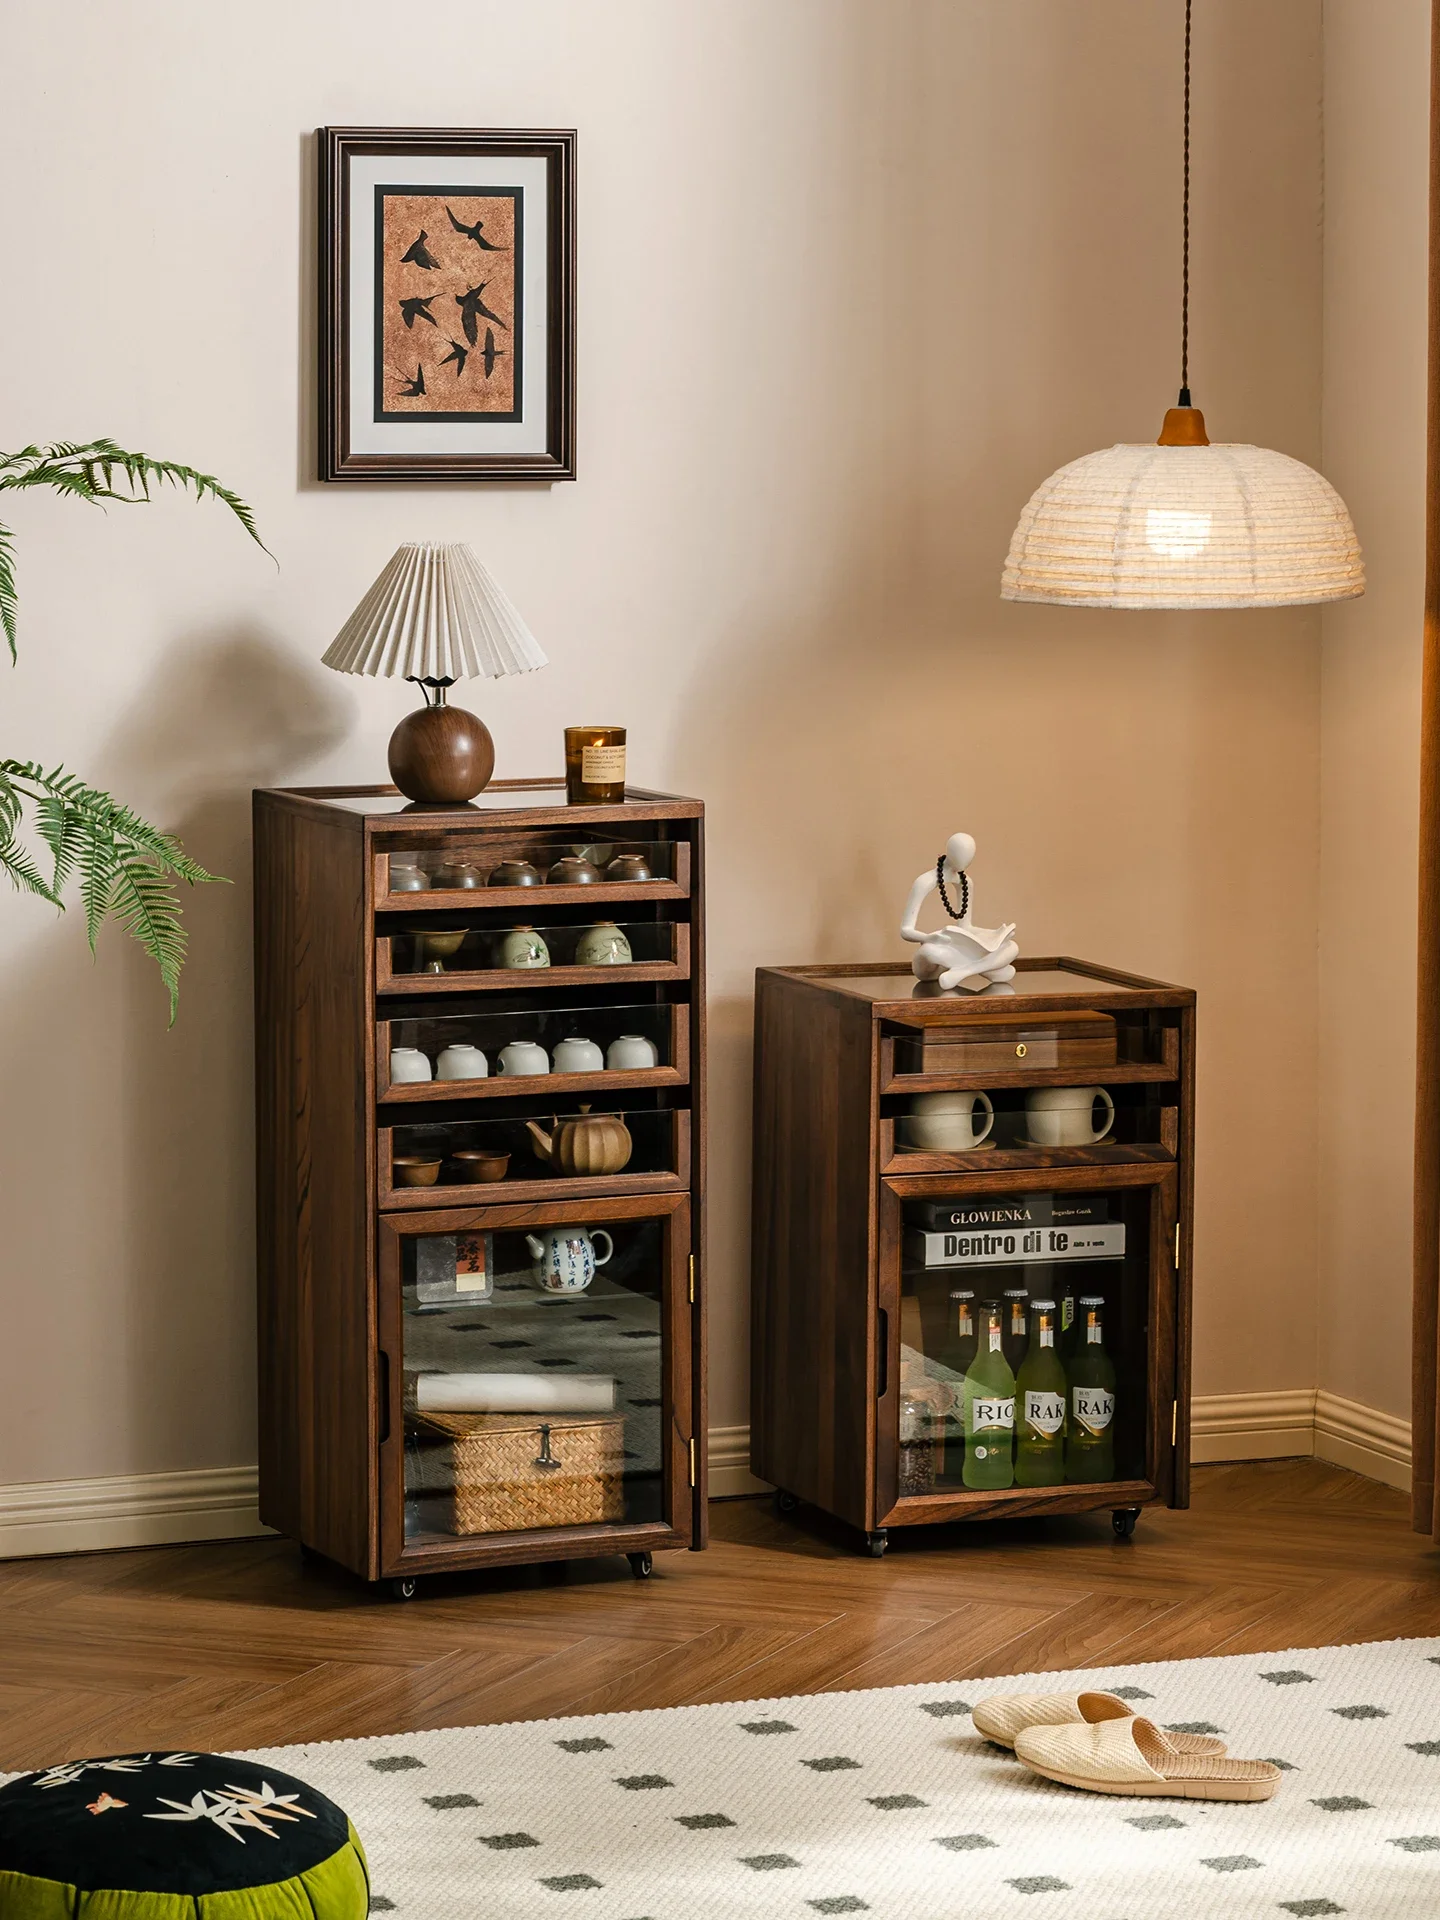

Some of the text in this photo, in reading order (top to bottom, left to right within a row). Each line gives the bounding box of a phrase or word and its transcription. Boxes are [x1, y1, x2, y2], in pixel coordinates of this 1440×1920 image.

[950, 1209, 1032, 1225] GŁOWIENKA
[944, 1230, 1069, 1258] Dentro di te
[1066, 1300, 1074, 1321] RIO
[976, 1404, 1014, 1421] RIO
